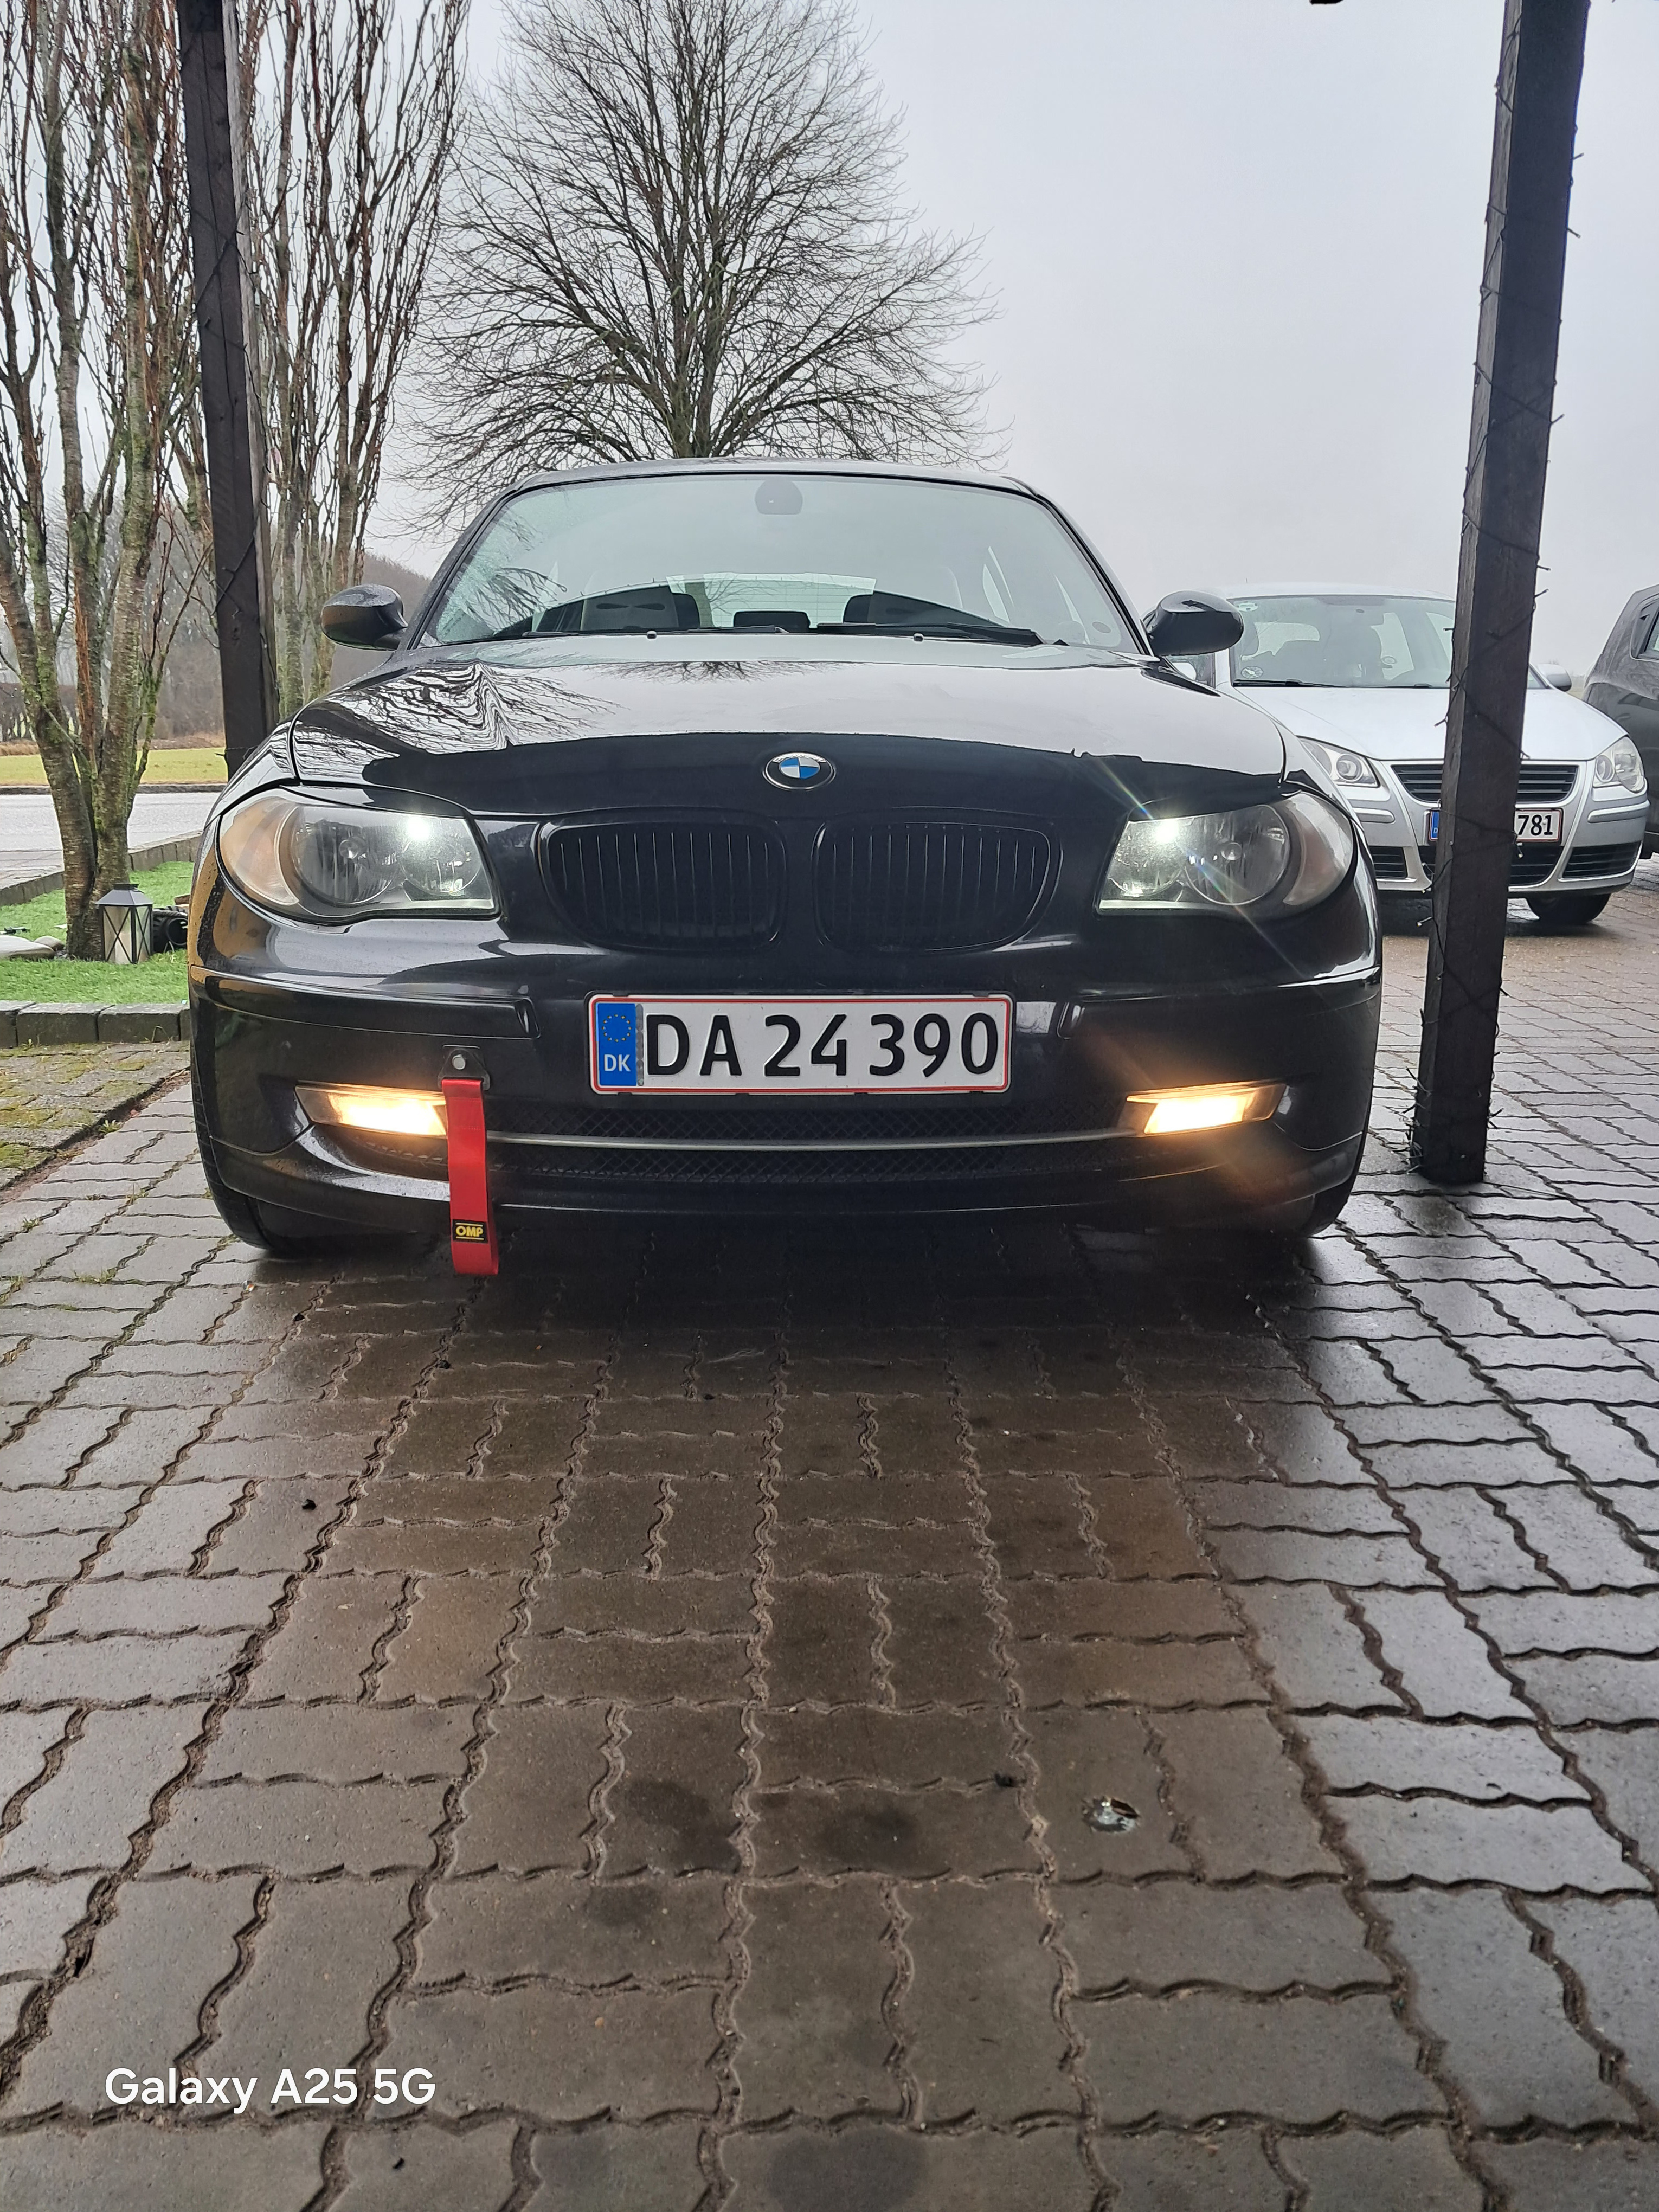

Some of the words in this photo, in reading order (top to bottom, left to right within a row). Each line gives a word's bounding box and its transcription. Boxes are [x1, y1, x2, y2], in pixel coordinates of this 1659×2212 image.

[1517, 814, 1553, 836] 781
[646, 1014, 742, 1076] DA
[764, 1014, 847, 1077] 24
[870, 1012, 998, 1078] 390
[605, 1054, 631, 1072] DK
[456, 1226, 484, 1237] OMP
